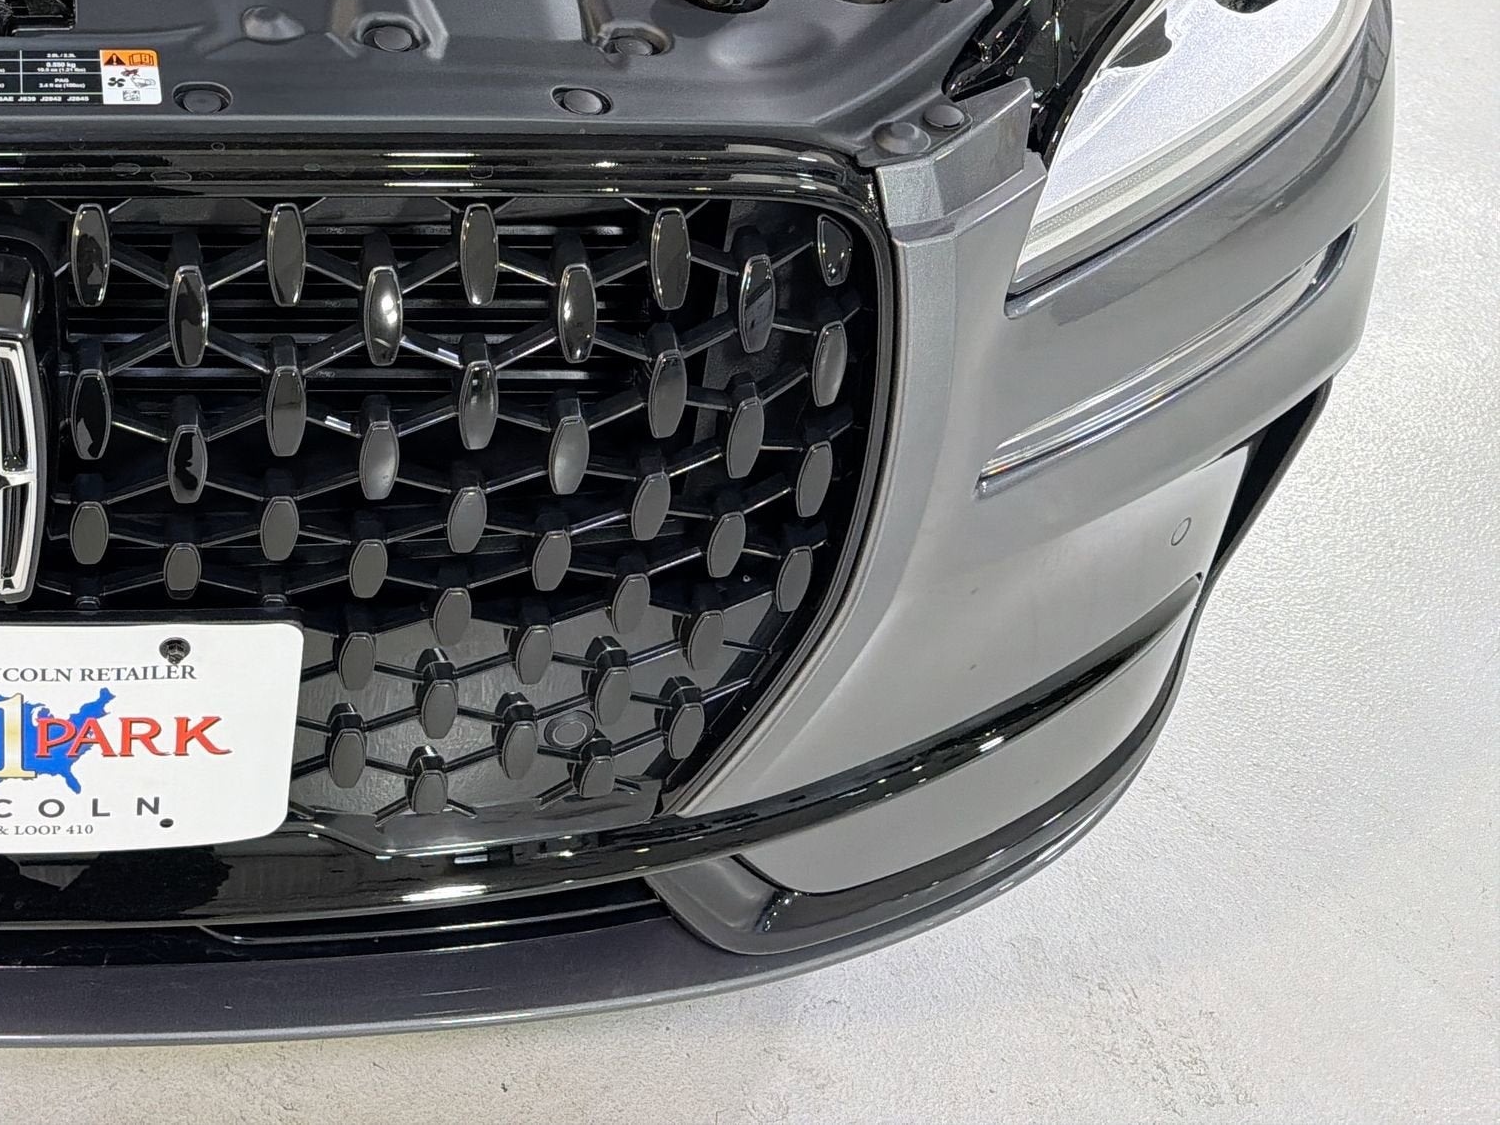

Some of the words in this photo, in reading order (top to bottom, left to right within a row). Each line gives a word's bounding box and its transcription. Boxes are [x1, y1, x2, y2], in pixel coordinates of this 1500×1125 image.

[79, 664, 198, 682] RETAILER
[35, 716, 232, 759] PARK
[14, 825, 61, 835] LOOP
[65, 824, 94, 835] 410
